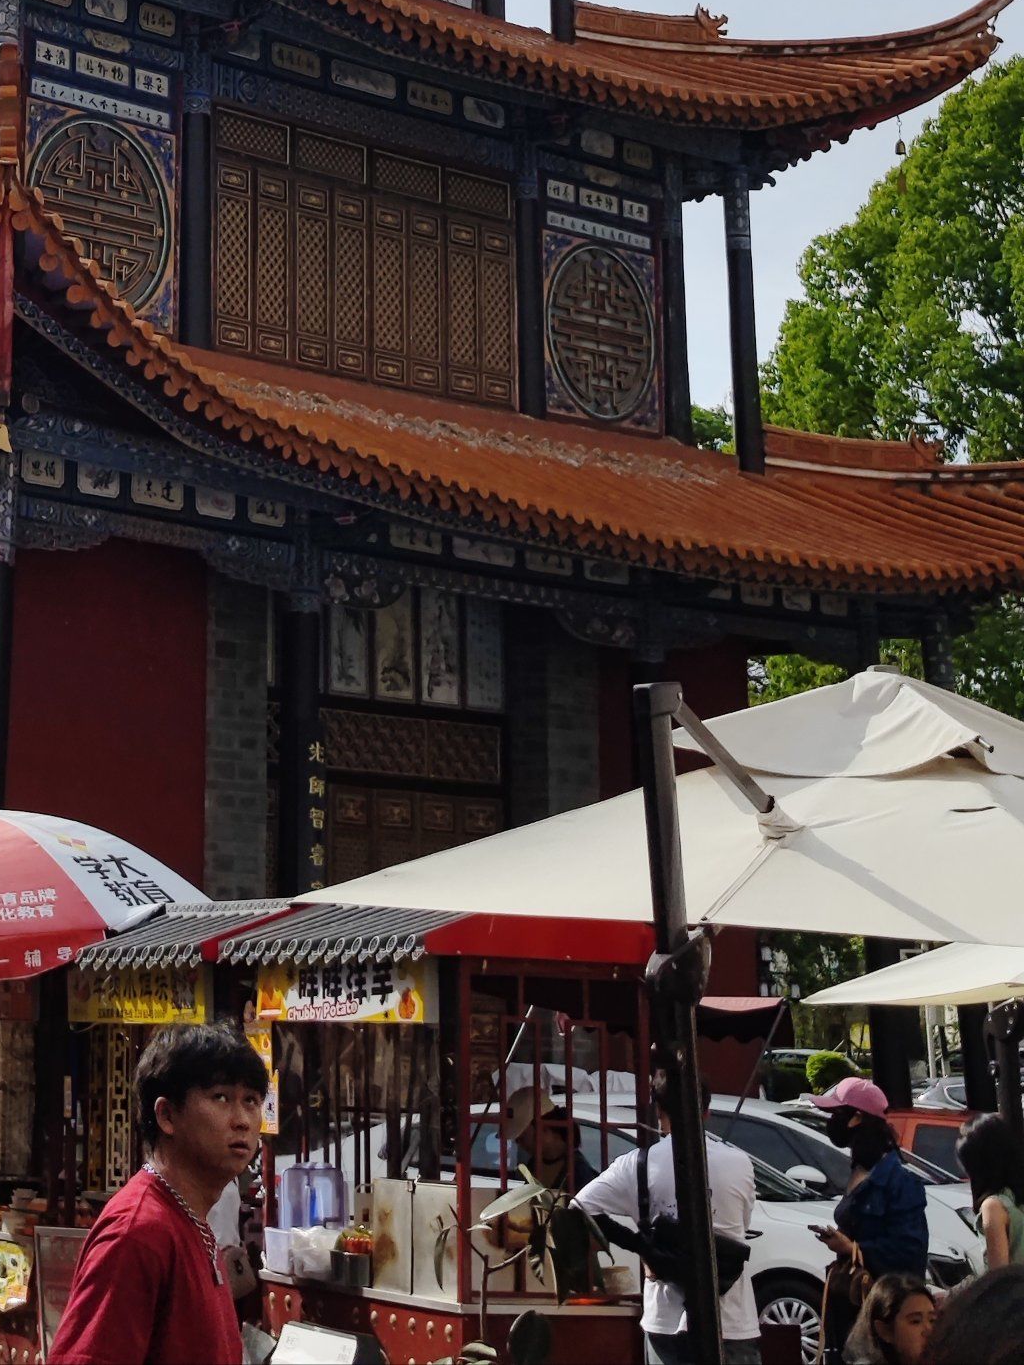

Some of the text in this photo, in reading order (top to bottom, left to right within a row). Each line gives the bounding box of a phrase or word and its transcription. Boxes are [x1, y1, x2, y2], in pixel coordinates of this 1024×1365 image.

[72, 854, 148, 880] 学大
[103, 880, 176, 907] 教育
[287, 1000, 359, 1021] Chubby Potato
